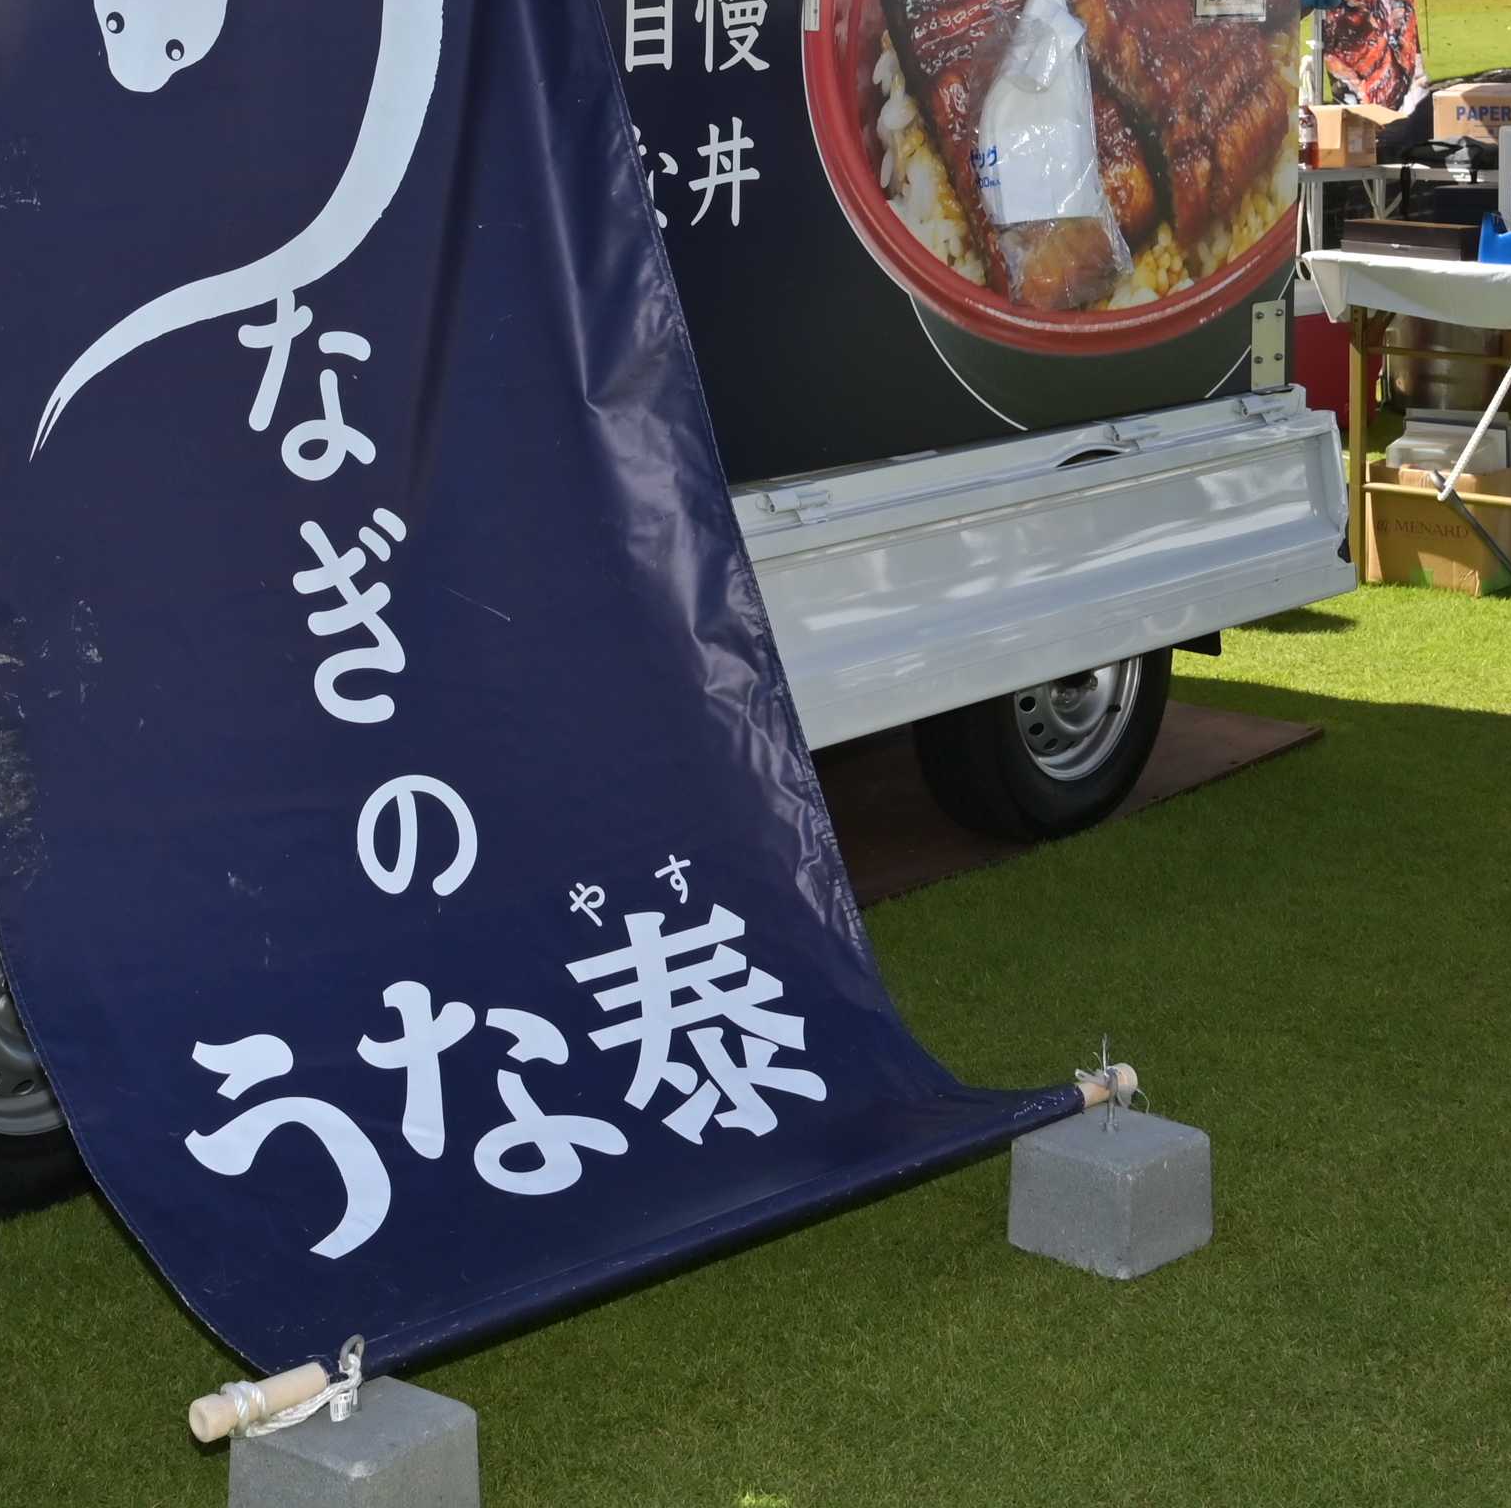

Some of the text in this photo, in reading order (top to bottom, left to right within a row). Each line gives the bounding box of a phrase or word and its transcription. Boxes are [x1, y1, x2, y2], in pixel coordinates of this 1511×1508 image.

[1456, 106, 1511, 121] PAPER
[1395, 518, 1469, 539] MENARD
[570, 855, 690, 925] やす
[185, 903, 827, 1260] うな泰
